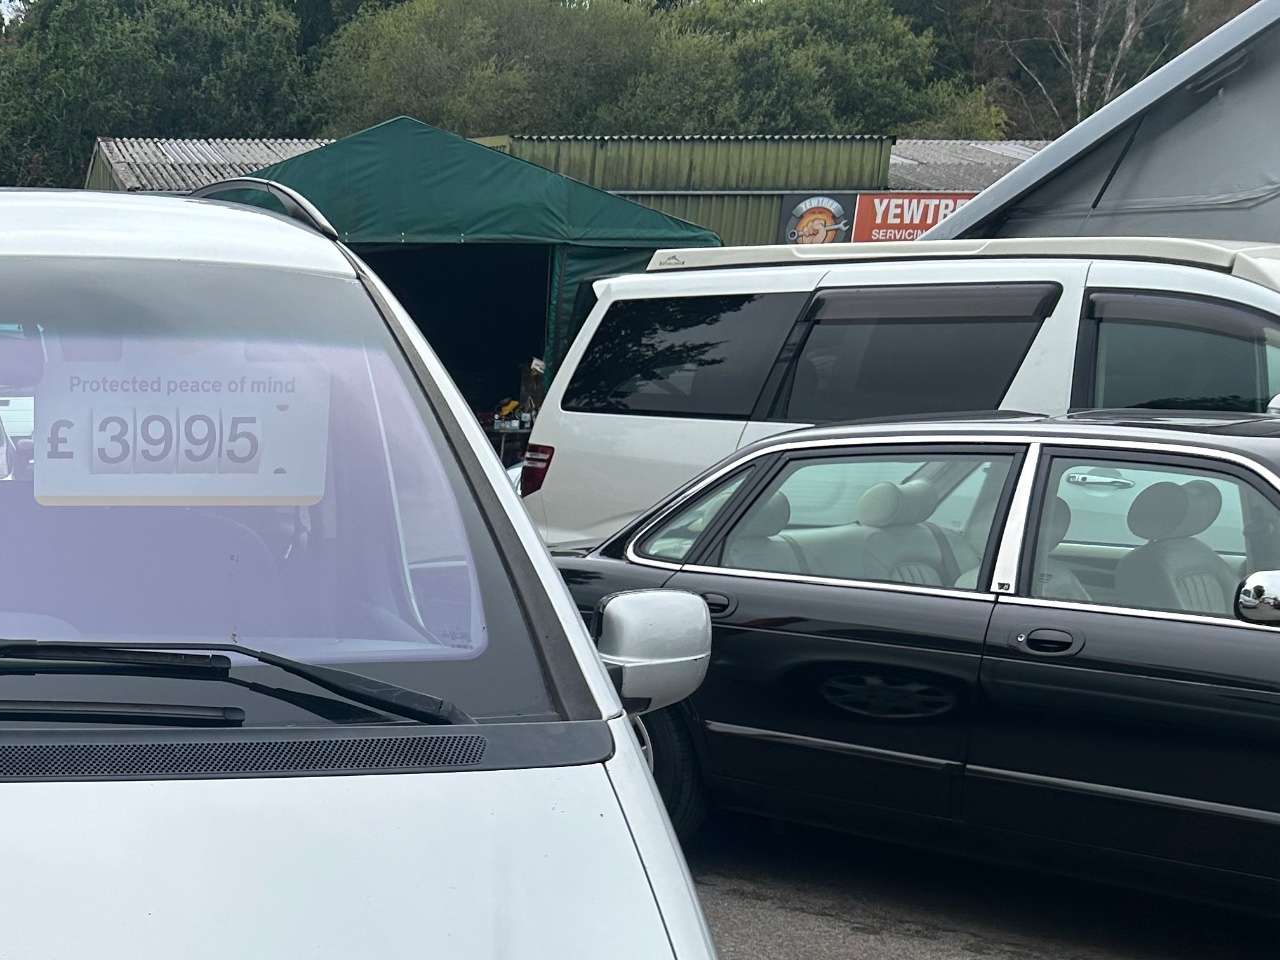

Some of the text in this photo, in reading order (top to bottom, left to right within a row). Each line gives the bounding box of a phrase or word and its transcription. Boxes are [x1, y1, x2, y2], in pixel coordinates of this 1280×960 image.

[69, 375, 296, 396] Protected peace of mind
[46, 414, 259, 465] £ 3995
